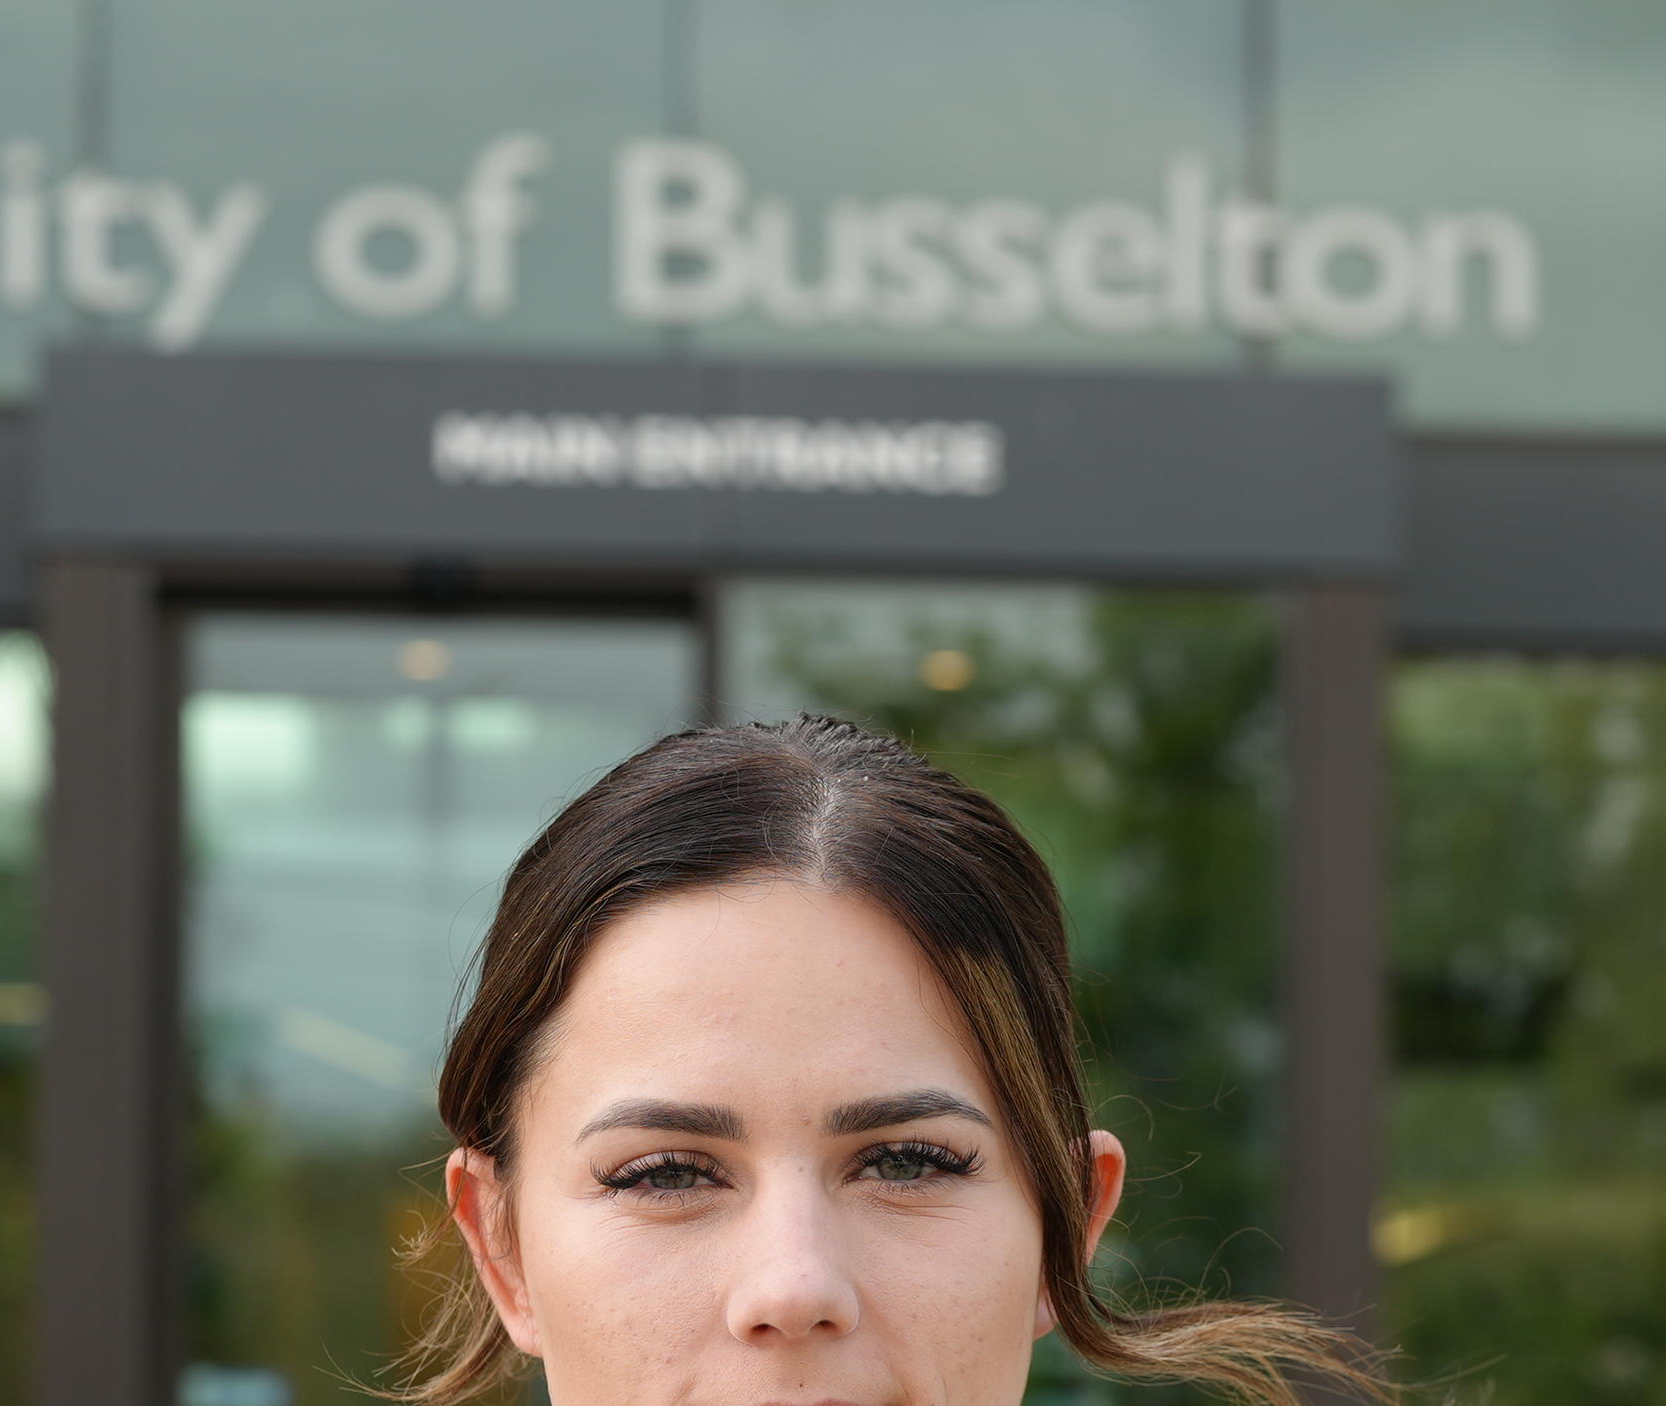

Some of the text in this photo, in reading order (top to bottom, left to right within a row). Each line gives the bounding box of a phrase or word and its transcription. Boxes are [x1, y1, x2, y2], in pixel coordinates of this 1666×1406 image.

[313, 130, 549, 319] of
[614, 139, 1539, 339] Busselton
[434, 411, 1004, 496] MAIN ENTRANCE
